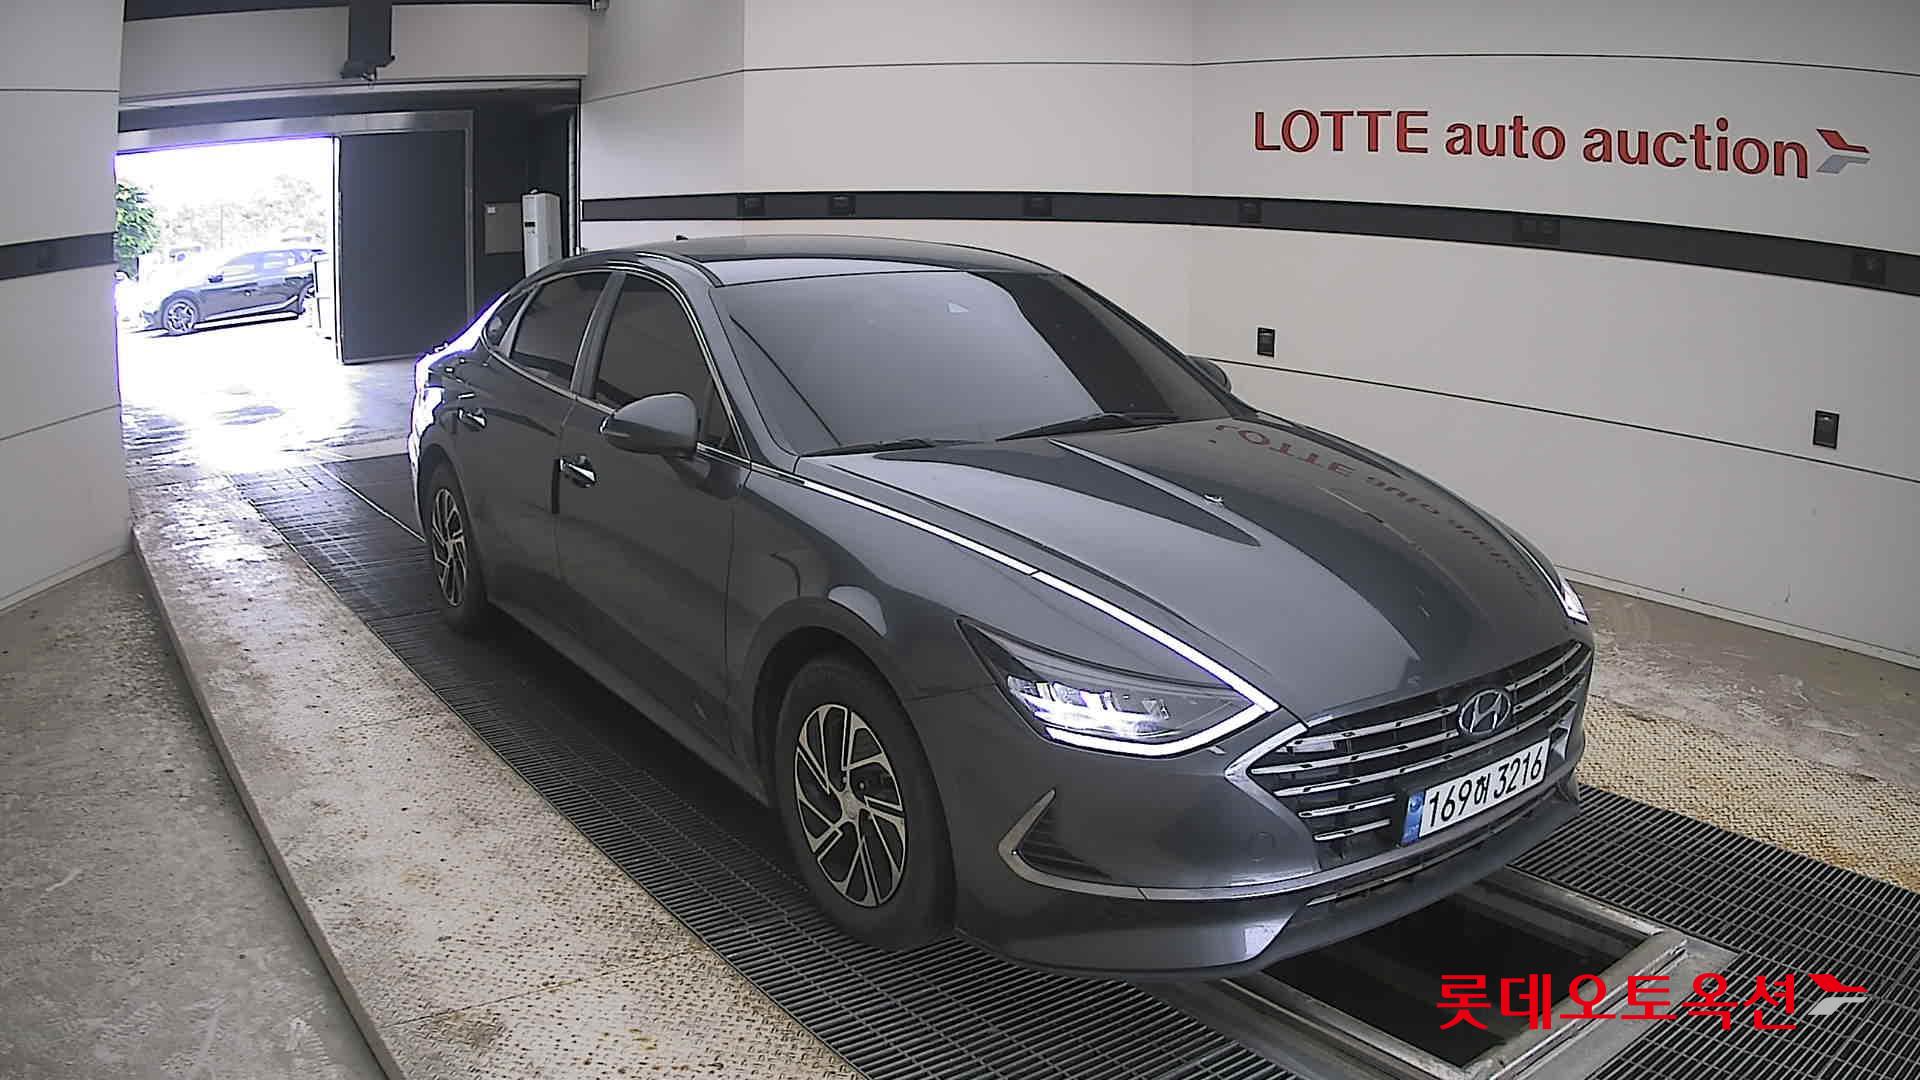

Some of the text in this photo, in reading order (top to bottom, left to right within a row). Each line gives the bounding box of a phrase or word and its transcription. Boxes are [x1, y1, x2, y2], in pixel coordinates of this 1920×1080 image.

[1254, 110, 1808, 179] LOTTE auto auction
